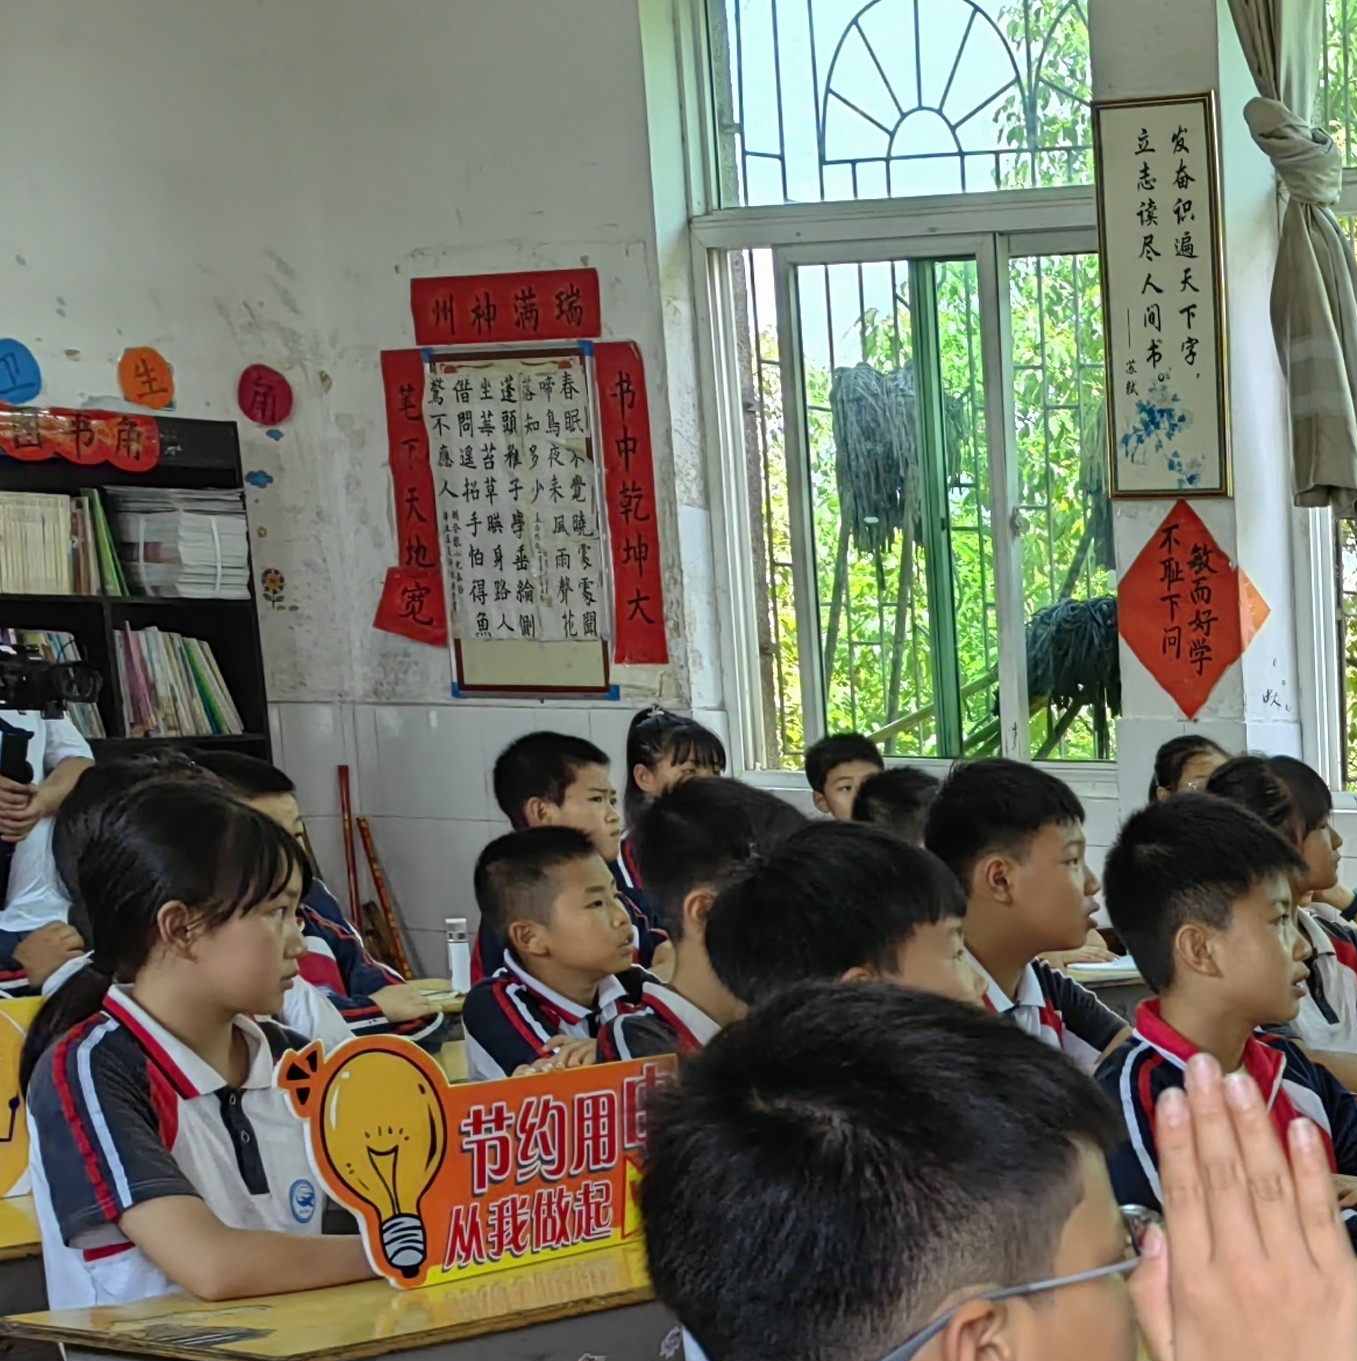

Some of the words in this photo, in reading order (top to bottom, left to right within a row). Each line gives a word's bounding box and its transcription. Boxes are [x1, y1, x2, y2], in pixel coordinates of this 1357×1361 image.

[398, 384, 436, 626] 笔下天地宽
[610, 370, 655, 625] 书中乾坤大
[1159, 524, 1185, 660] 不耻下问
[1187, 543, 1219, 677] 敏而好学
[441, 1180, 614, 1275] 从我做起
